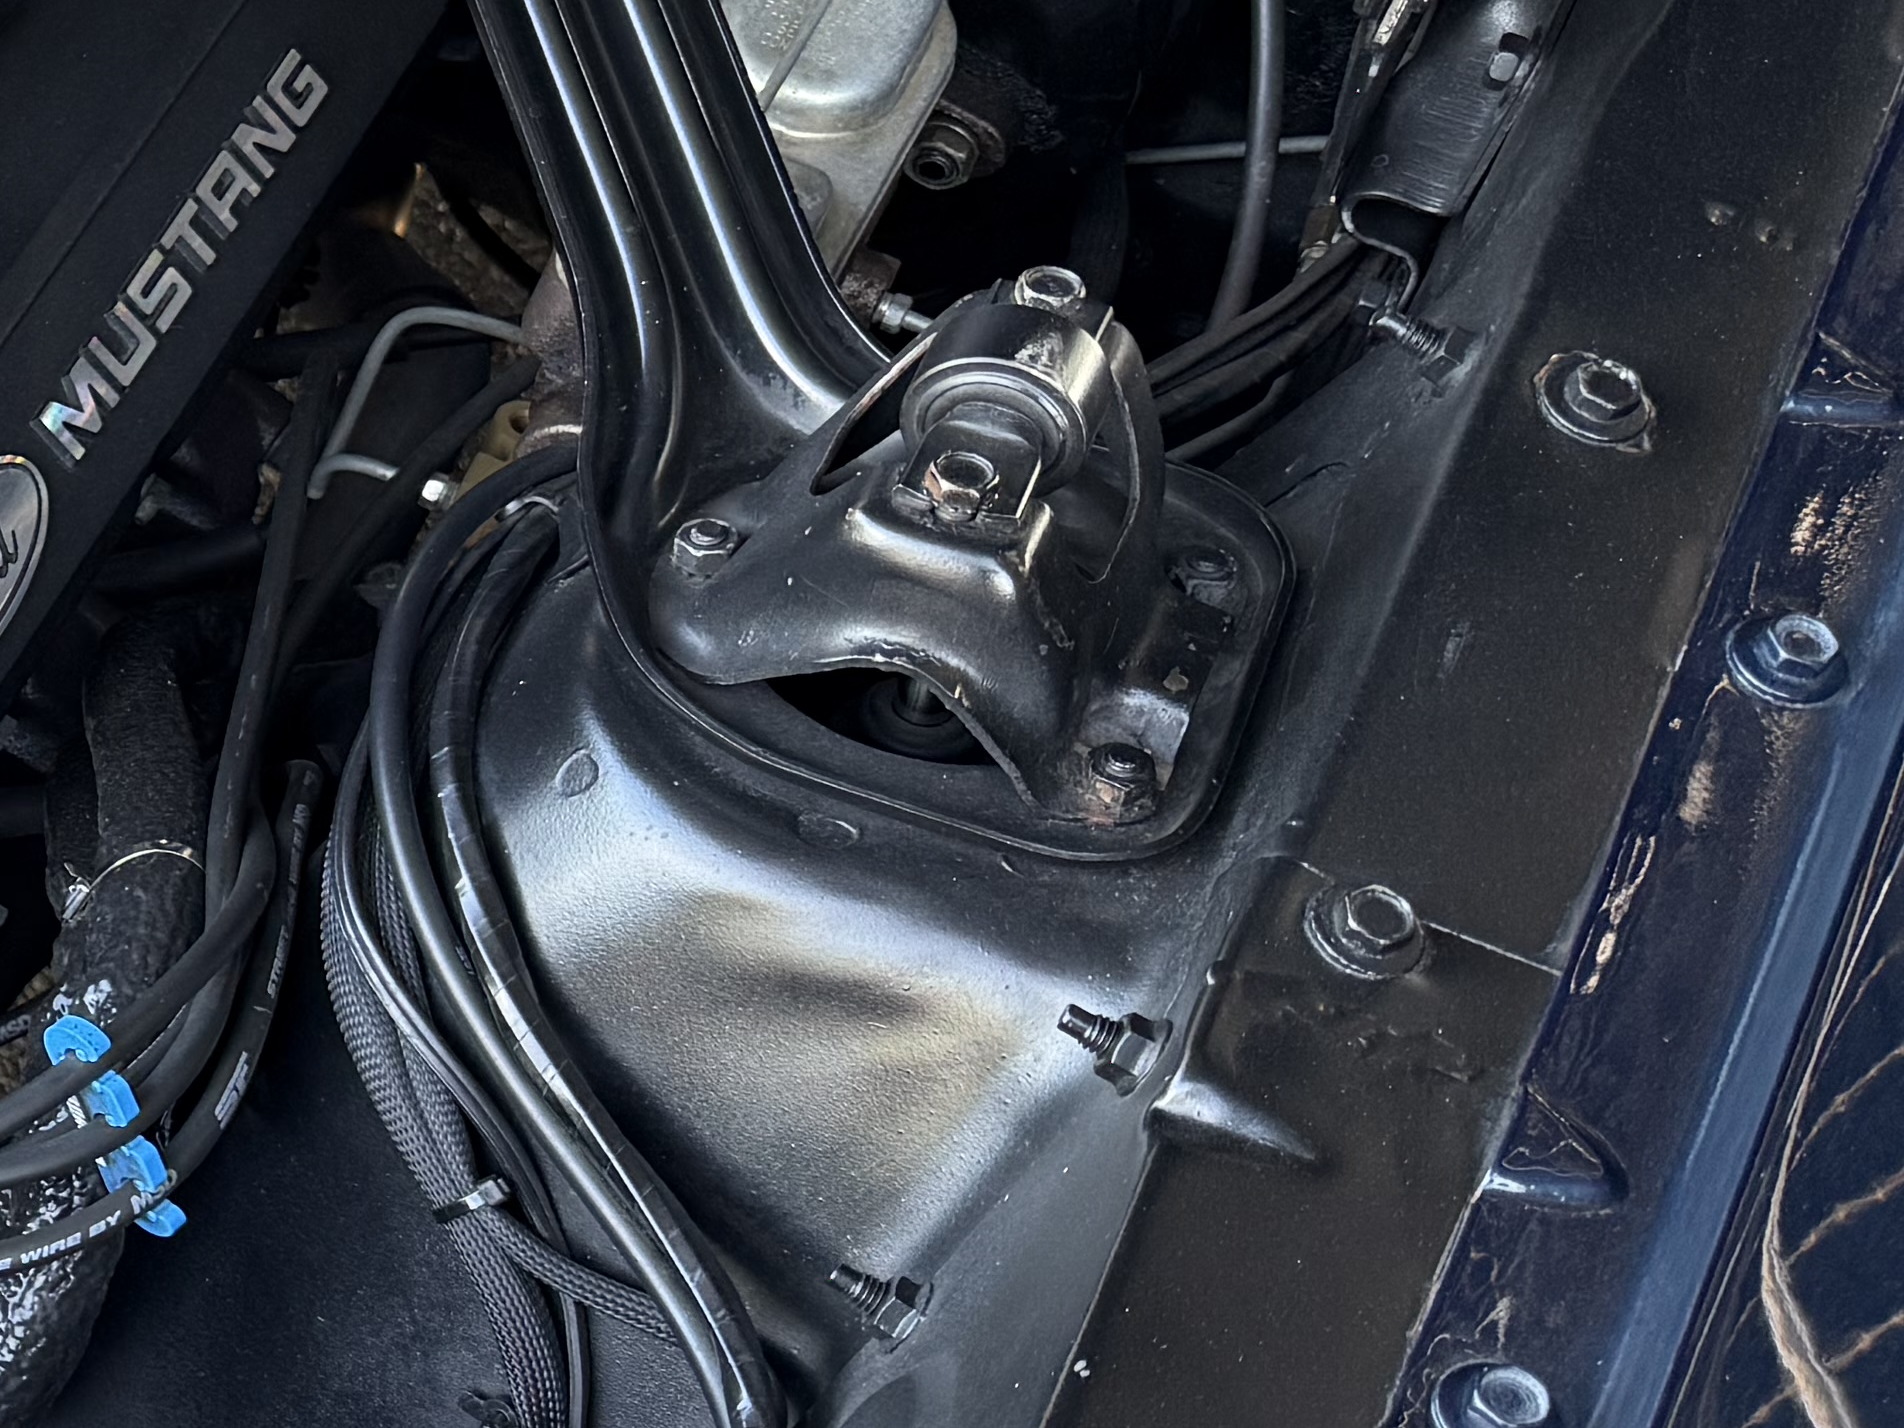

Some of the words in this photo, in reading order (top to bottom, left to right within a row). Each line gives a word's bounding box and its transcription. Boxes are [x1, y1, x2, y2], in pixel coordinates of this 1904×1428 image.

[32, 47, 328, 468] MUSTANG
[20, 1231, 84, 1266] WIRE
[88, 1209, 122, 1239] BY
